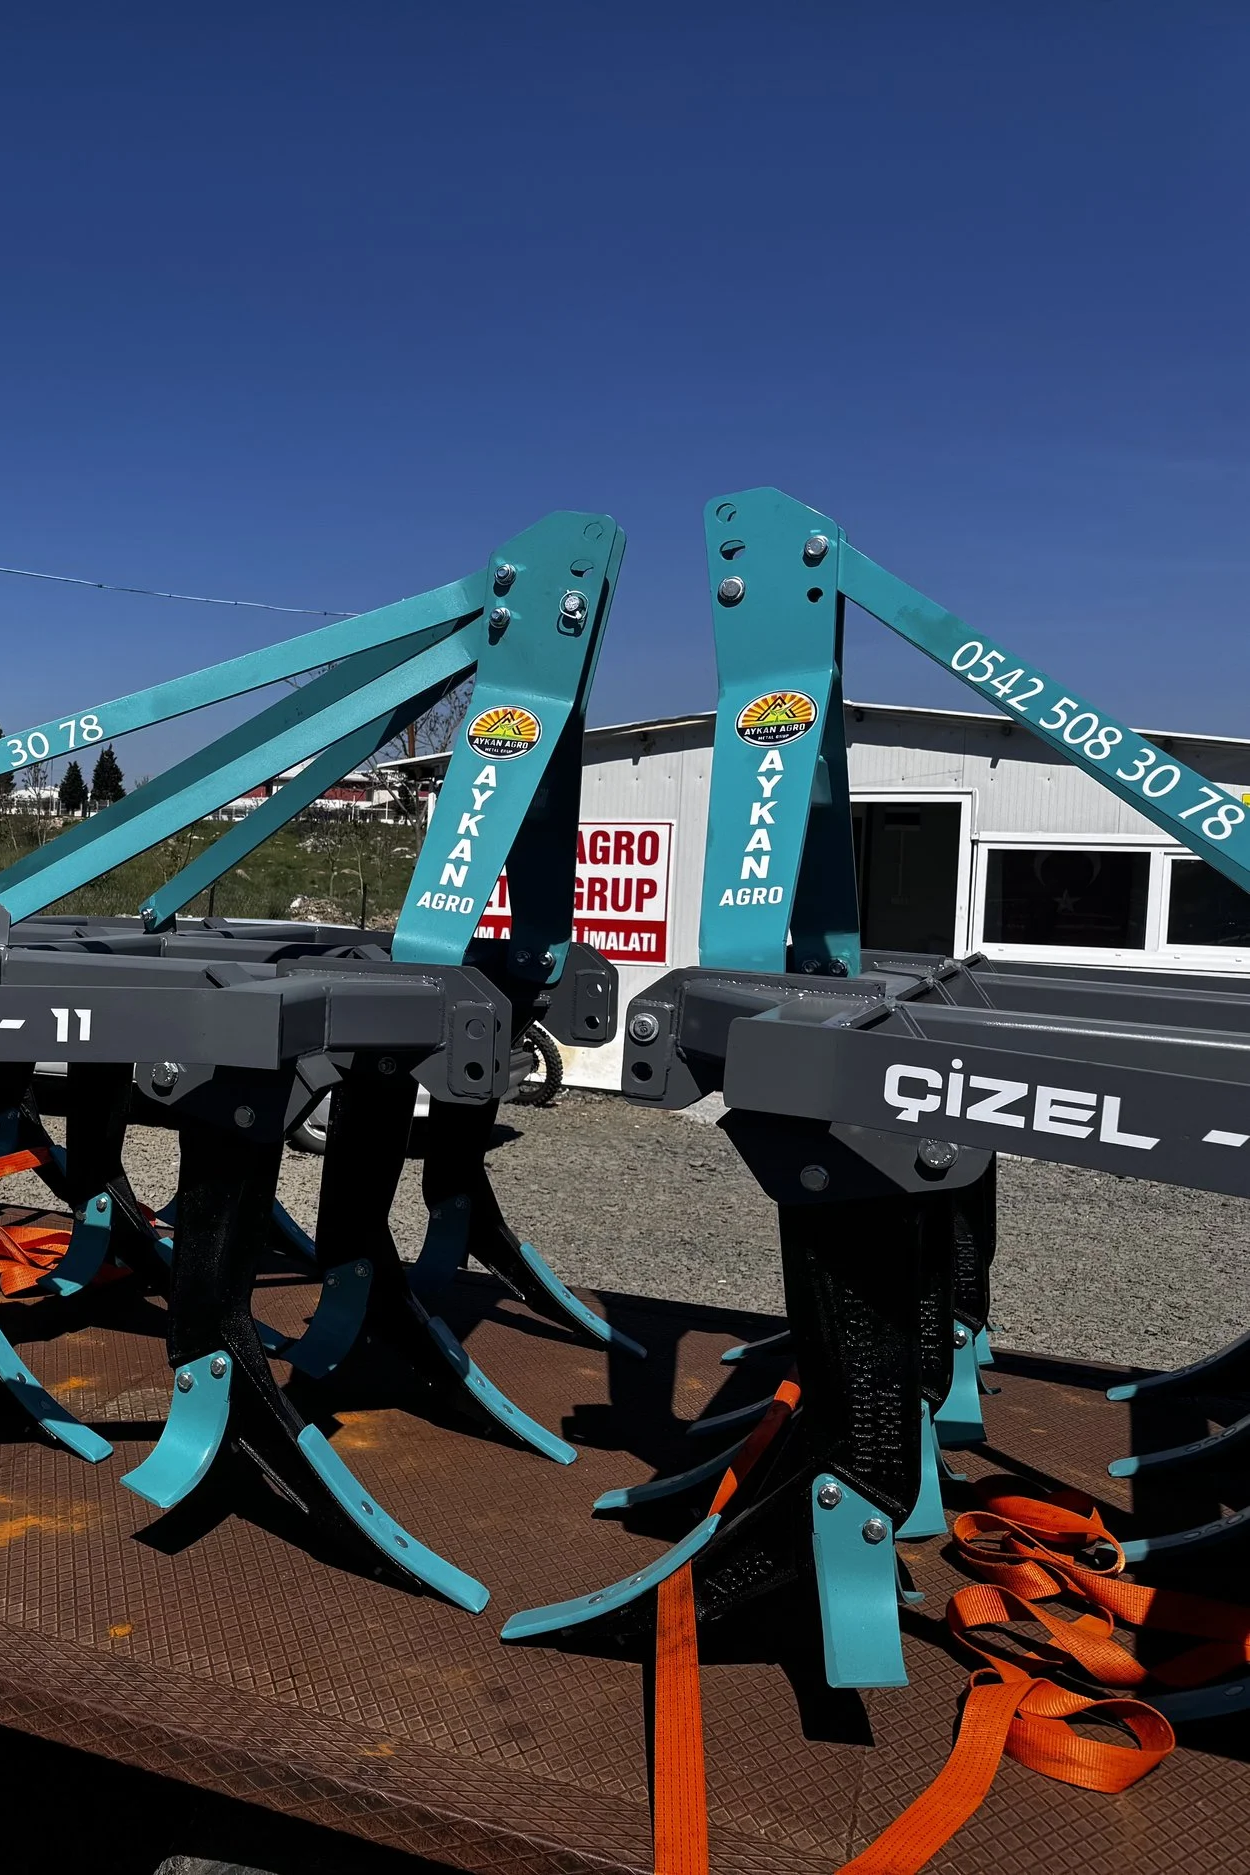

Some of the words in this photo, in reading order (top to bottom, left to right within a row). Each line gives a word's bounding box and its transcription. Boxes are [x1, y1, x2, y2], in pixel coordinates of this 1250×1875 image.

[6, 731, 49, 767] 30
[59, 714, 103, 749] 78
[473, 737, 502, 747] AYKAN
[505, 740, 529, 749] AGRO
[744, 726, 777, 736] AYKAN
[779, 723, 806, 733] AGRO
[951, 641, 1044, 712] 0542
[1039, 697, 1123, 760] 508
[1116, 748, 1181, 798] 30
[1178, 786, 1245, 840] 78
[439, 765, 497, 888] AYKAN
[740, 749, 784, 880] AYKAN
[416, 891, 475, 914] AGRO
[719, 886, 784, 907] AGRO
[584, 926, 657, 952] İMALATI
[50, 1007, 92, 1043] 11
[883, 1058, 1161, 1150] ÇİZEL
